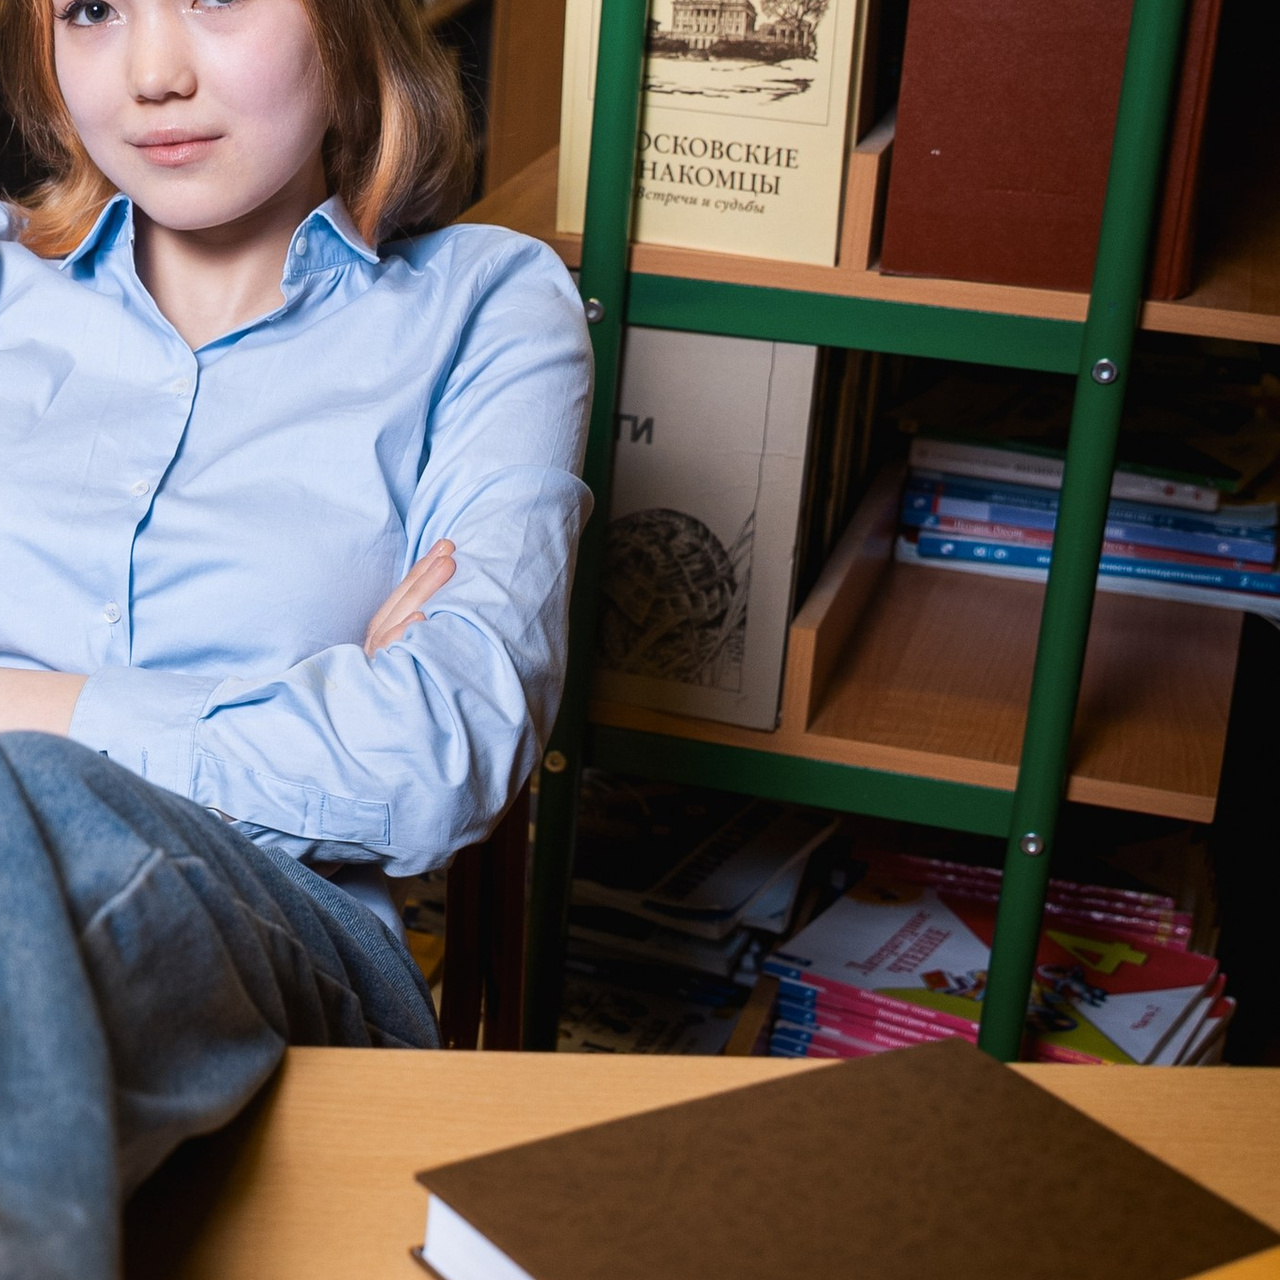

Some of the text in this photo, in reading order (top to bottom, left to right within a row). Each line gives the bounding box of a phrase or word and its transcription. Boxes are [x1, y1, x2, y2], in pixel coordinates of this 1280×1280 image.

[636, 131, 800, 170] ОСКОВСКИЕ
[638, 159, 782, 197] НАКОМЦЫ
[636, 186, 765, 214] Встречи и судьбы
